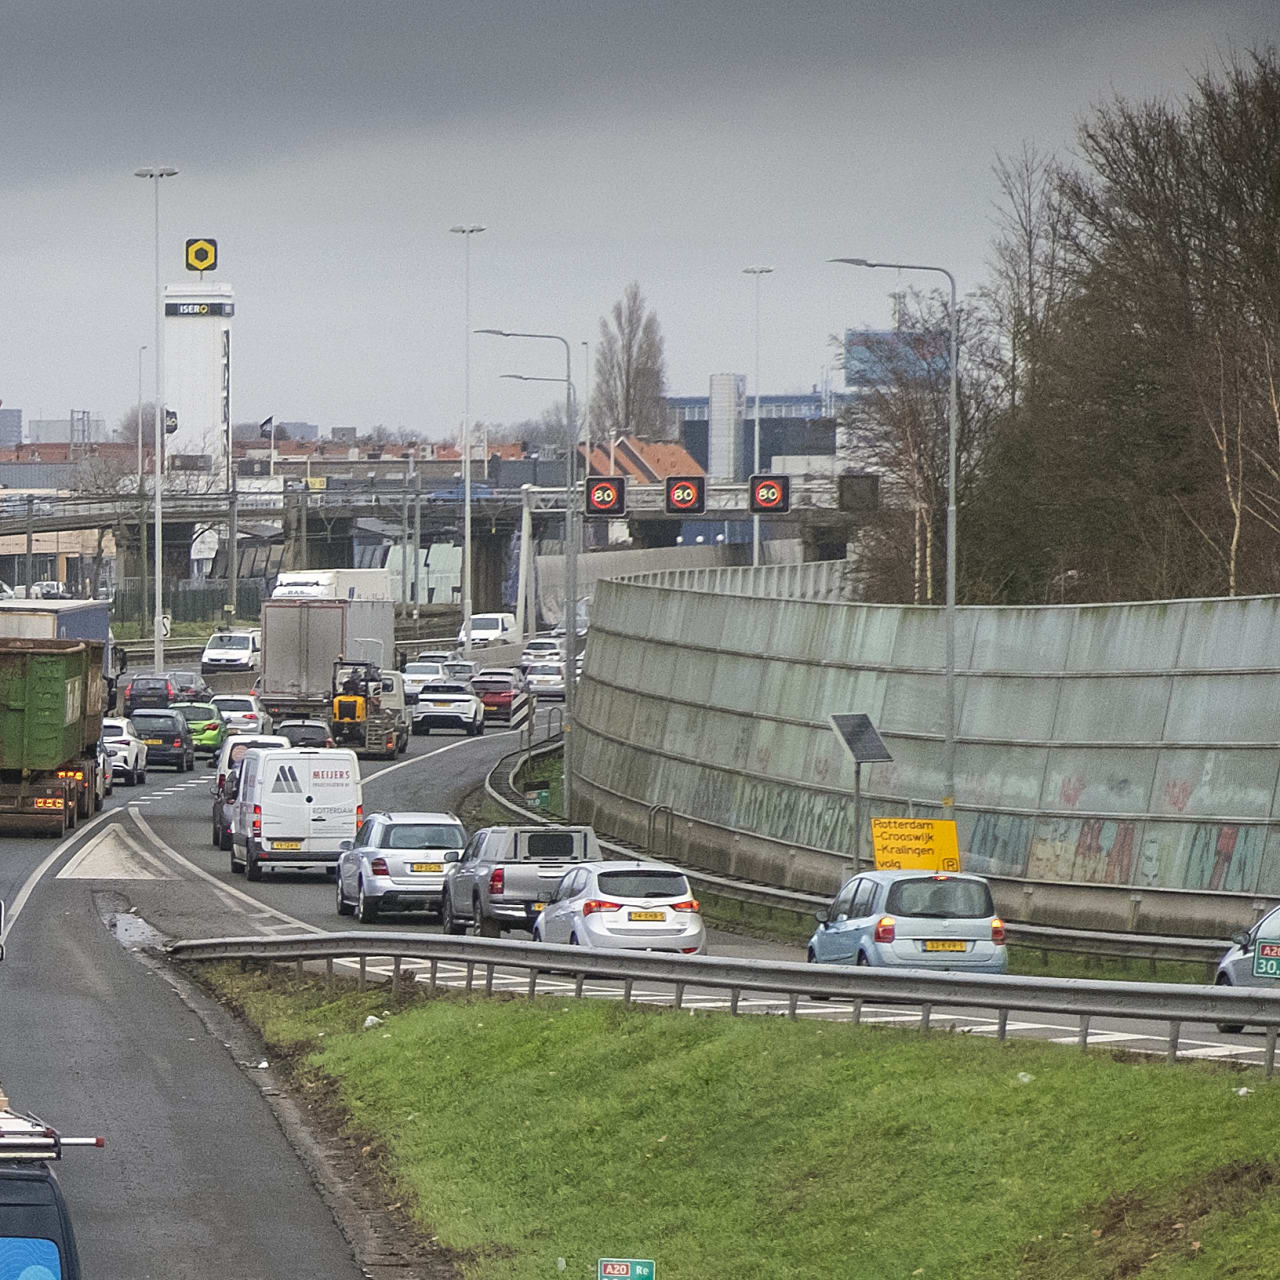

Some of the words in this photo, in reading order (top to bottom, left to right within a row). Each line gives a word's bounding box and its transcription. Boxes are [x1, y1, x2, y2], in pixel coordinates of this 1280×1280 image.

[180, 305, 208, 314] ISERO
[593, 490, 614, 501] 80
[673, 489, 694, 500] 80
[758, 488, 779, 499] 80
[312, 770, 350, 779] MEIJERS
[312, 807, 354, 815] ROTTERDAM
[873, 819, 934, 830] Rotterdam
[877, 844, 935, 857] -Kralingen
[878, 858, 901, 869] volg
[605, 1264, 627, 1274] A20
[635, 1266, 649, 1275] Re
